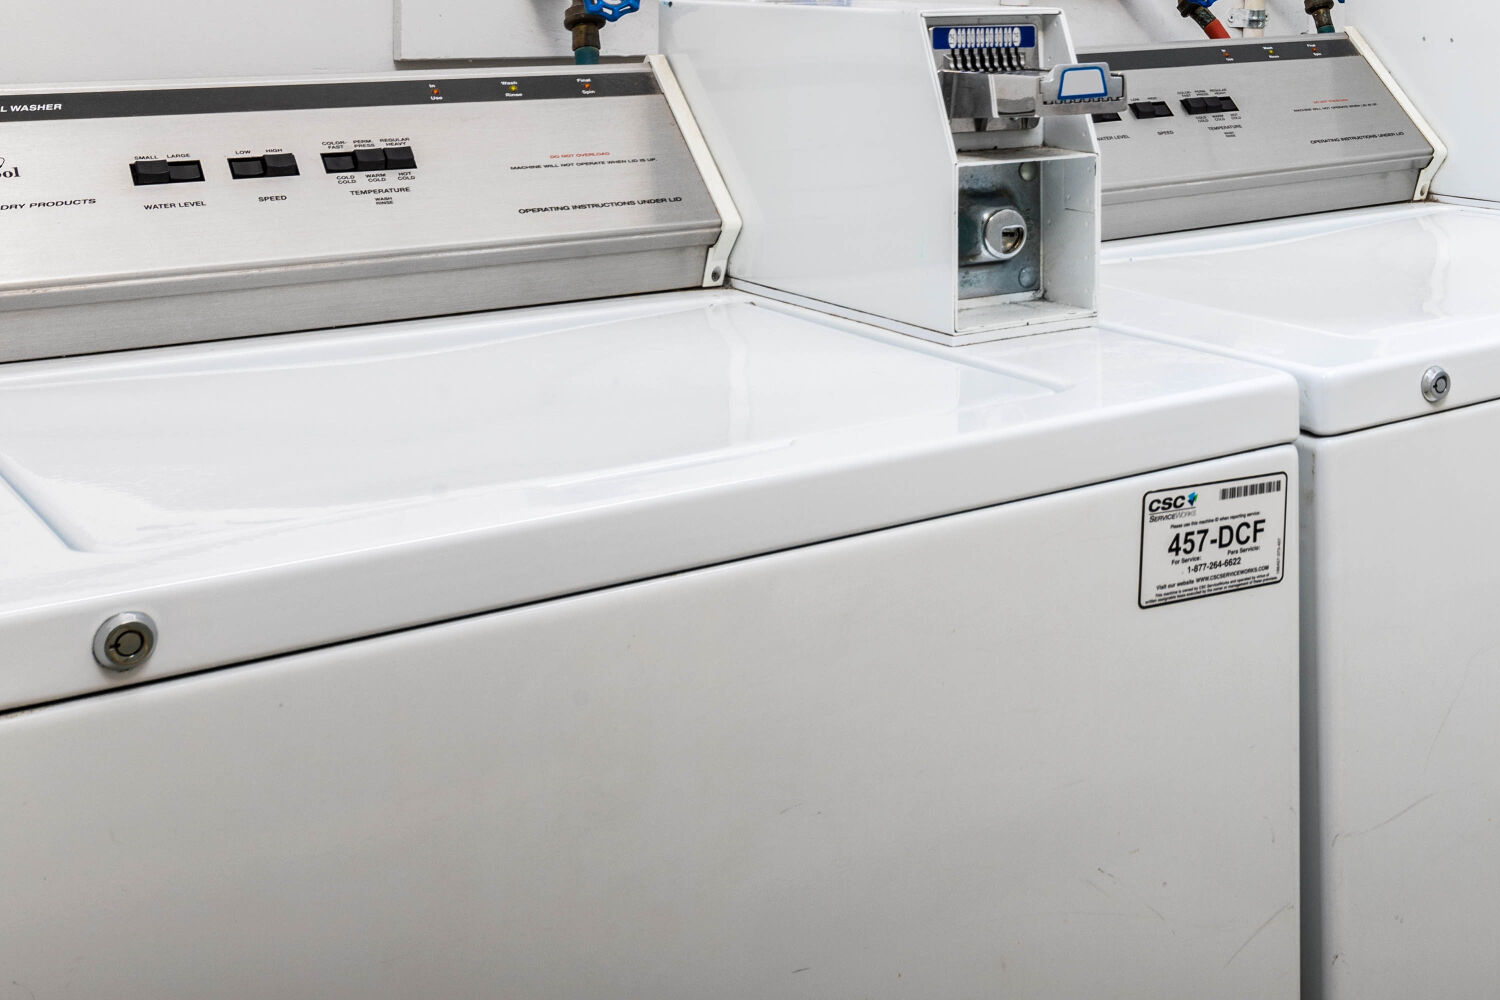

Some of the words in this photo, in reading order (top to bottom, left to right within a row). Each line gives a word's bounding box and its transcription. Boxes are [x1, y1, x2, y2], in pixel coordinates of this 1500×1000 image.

[10, 103, 62, 112] WASHER
[1310, 136, 1340, 144] OPERATING
[1341, 133, 1378, 142] INSTRUCTIONS
[349, 186, 410, 196] TEMPERATURE
[29, 198, 96, 208] PRODUCTS
[143, 202, 177, 210] WATER
[178, 200, 206, 208] LEVEL
[518, 205, 571, 214] OPERATING
[571, 200, 636, 210] INSTRUCTIONS
[1148, 495, 1186, 513] CSC
[1167, 518, 1266, 557] 457-DCF
[1187, 556, 1242, 574] 1-877-264-6622
